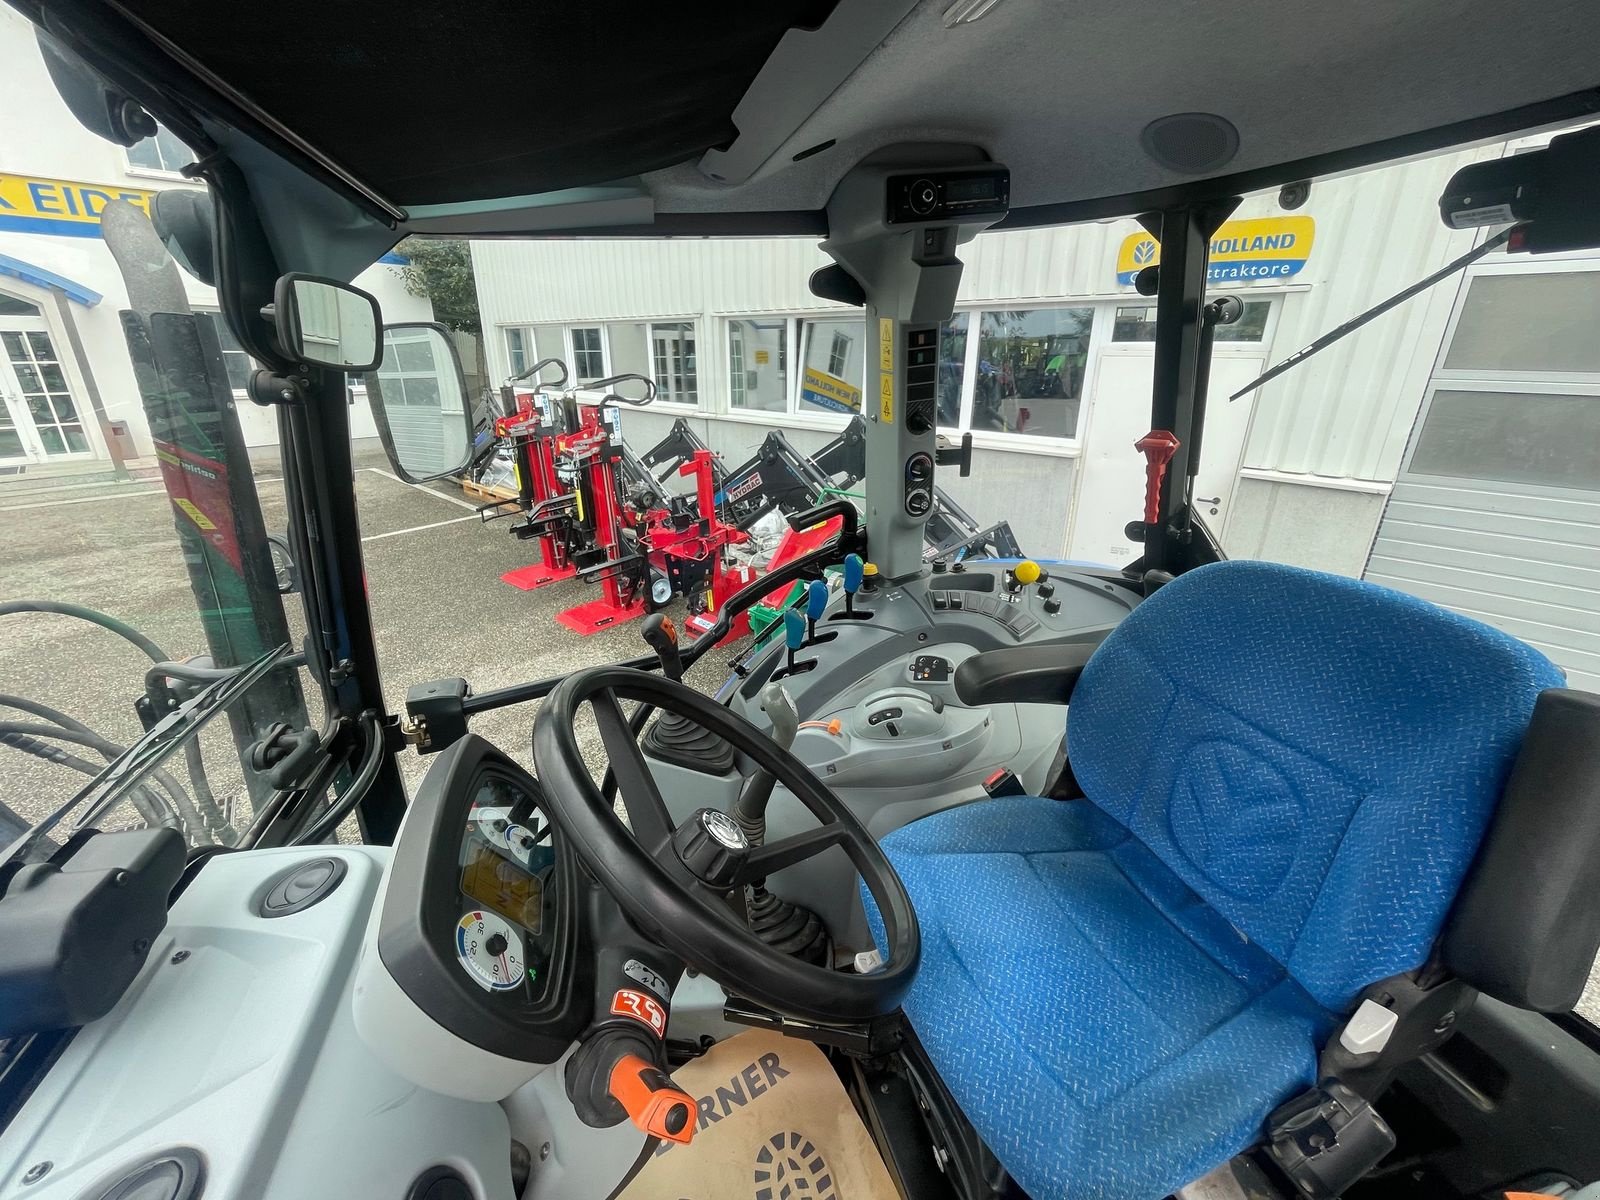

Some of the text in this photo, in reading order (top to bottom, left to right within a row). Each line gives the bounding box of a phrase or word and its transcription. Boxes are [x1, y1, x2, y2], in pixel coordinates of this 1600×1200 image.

[733, 478, 762, 500] HYDRAC
[477, 922, 485, 936] 30
[470, 940, 478, 956] 20
[510, 955, 516, 964] 0
[492, 964, 500, 976] 10
